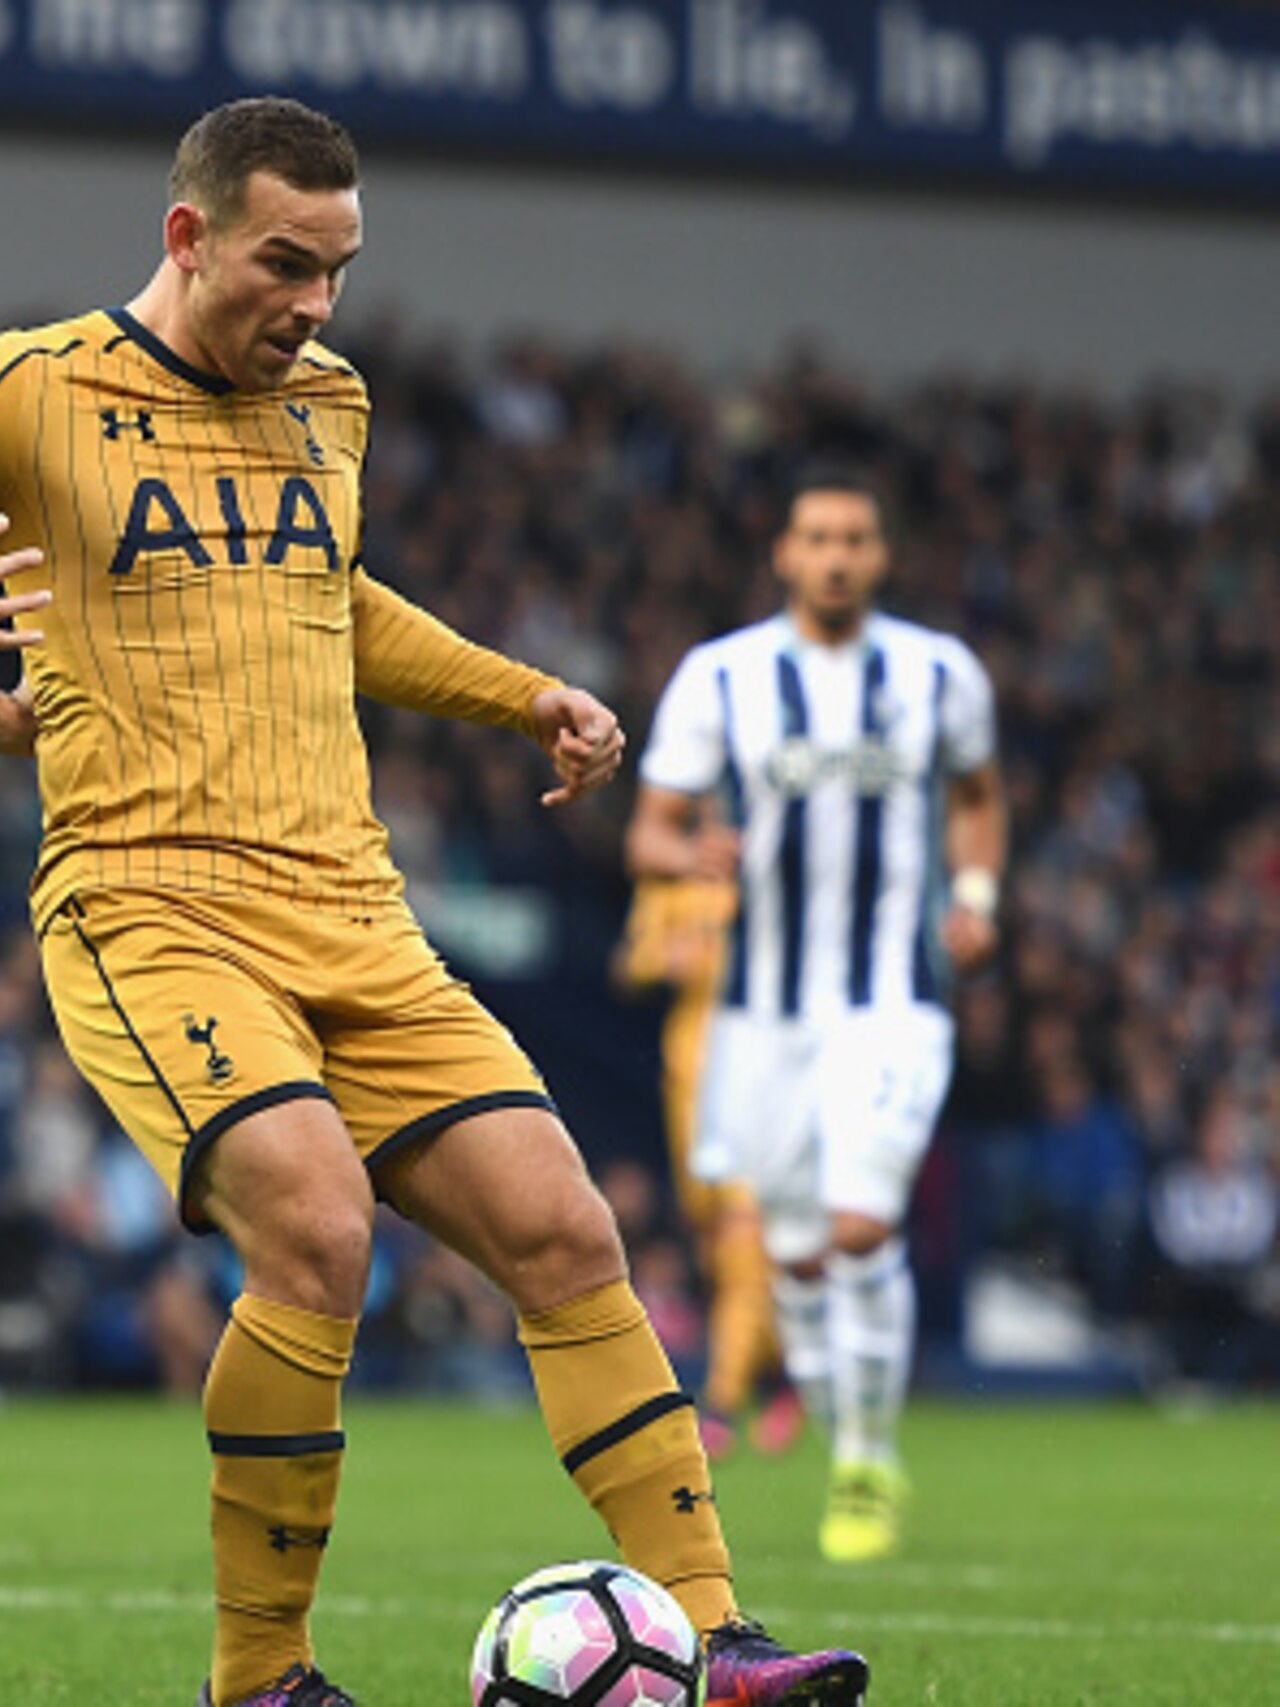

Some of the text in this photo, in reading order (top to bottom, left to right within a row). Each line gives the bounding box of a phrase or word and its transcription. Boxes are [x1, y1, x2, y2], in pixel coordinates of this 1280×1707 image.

[28, 0, 206, 78] me
[224, 0, 526, 90] down
[548, 0, 676, 110] to
[109, 477, 339, 575] AIA
